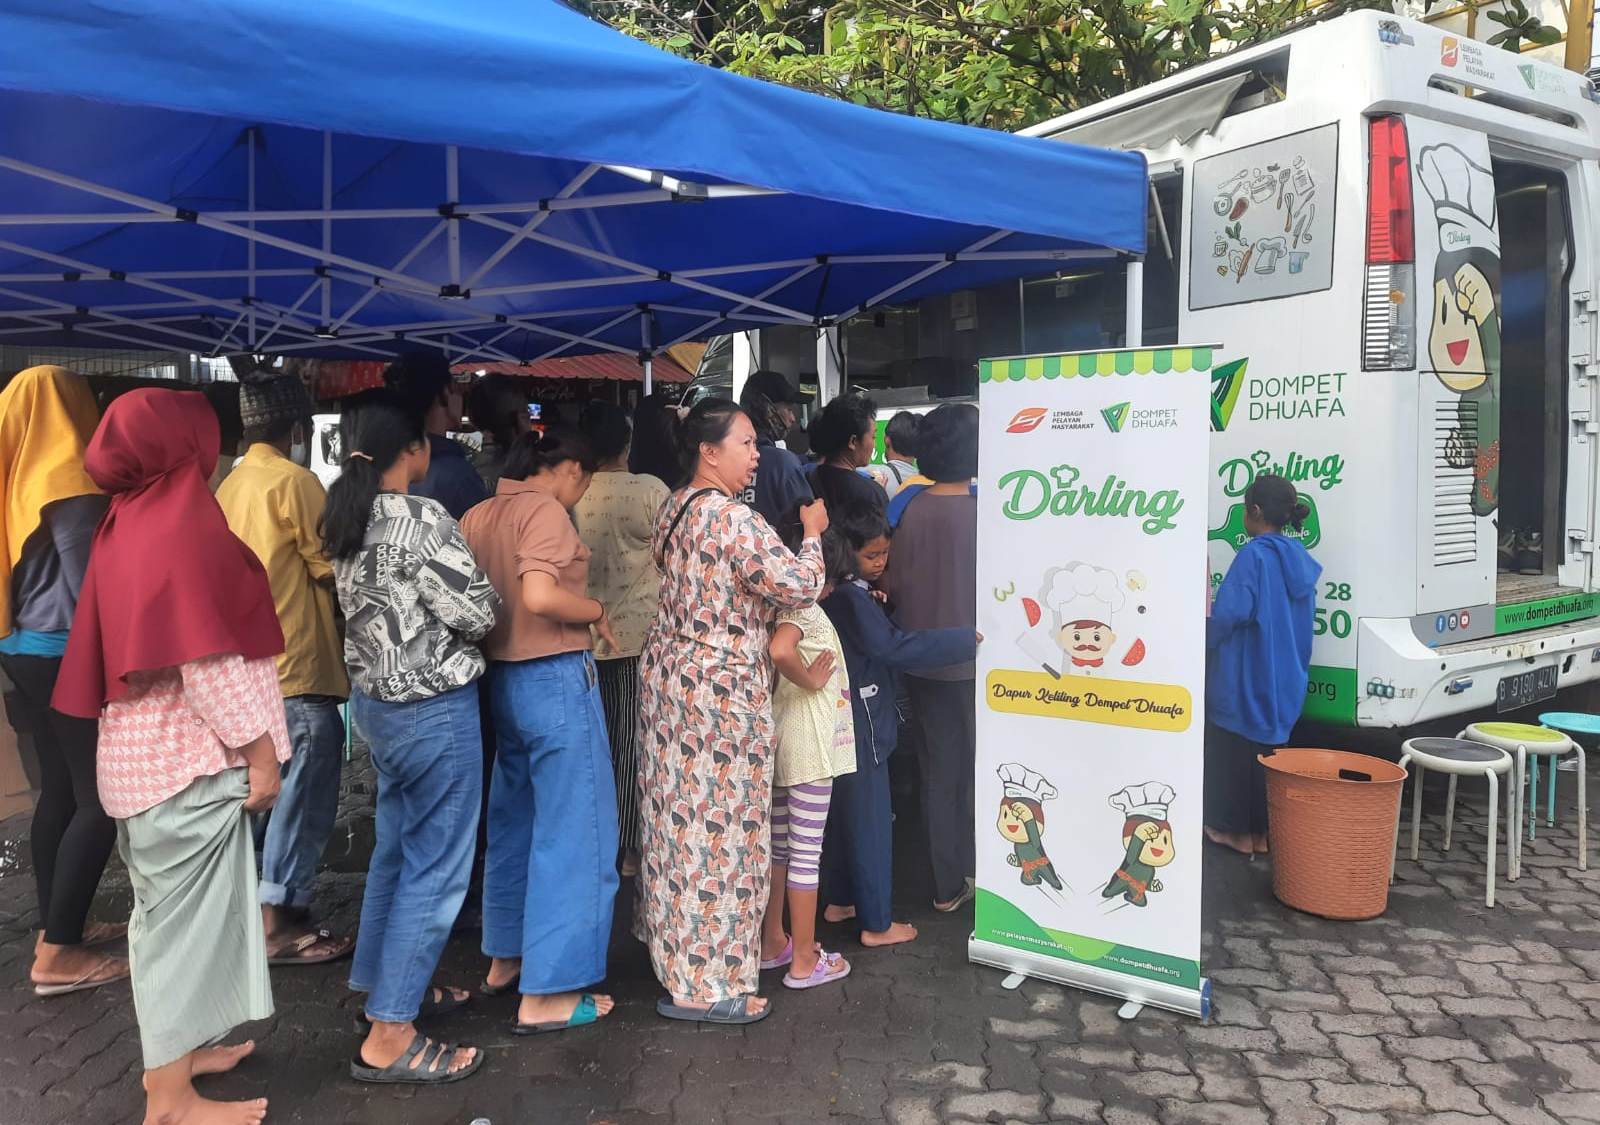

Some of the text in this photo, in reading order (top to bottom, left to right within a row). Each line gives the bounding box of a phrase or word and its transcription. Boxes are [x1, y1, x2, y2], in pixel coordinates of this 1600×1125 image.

[1250, 373, 1348, 398] DOMPET
[1132, 408, 1178, 419] DOMPET
[1249, 398, 1346, 420] DHUAFA
[1131, 418, 1178, 429] DHUAFA
[998, 468, 1185, 536] Darling
[1325, 581, 1352, 602] 28
[1504, 599, 1594, 625] www.dompetdhuafa.org
[992, 683, 1184, 719] Dapur Keliling Dompet Dhuafa
[1103, 955, 1180, 978] www.dompetdhuafa.org
